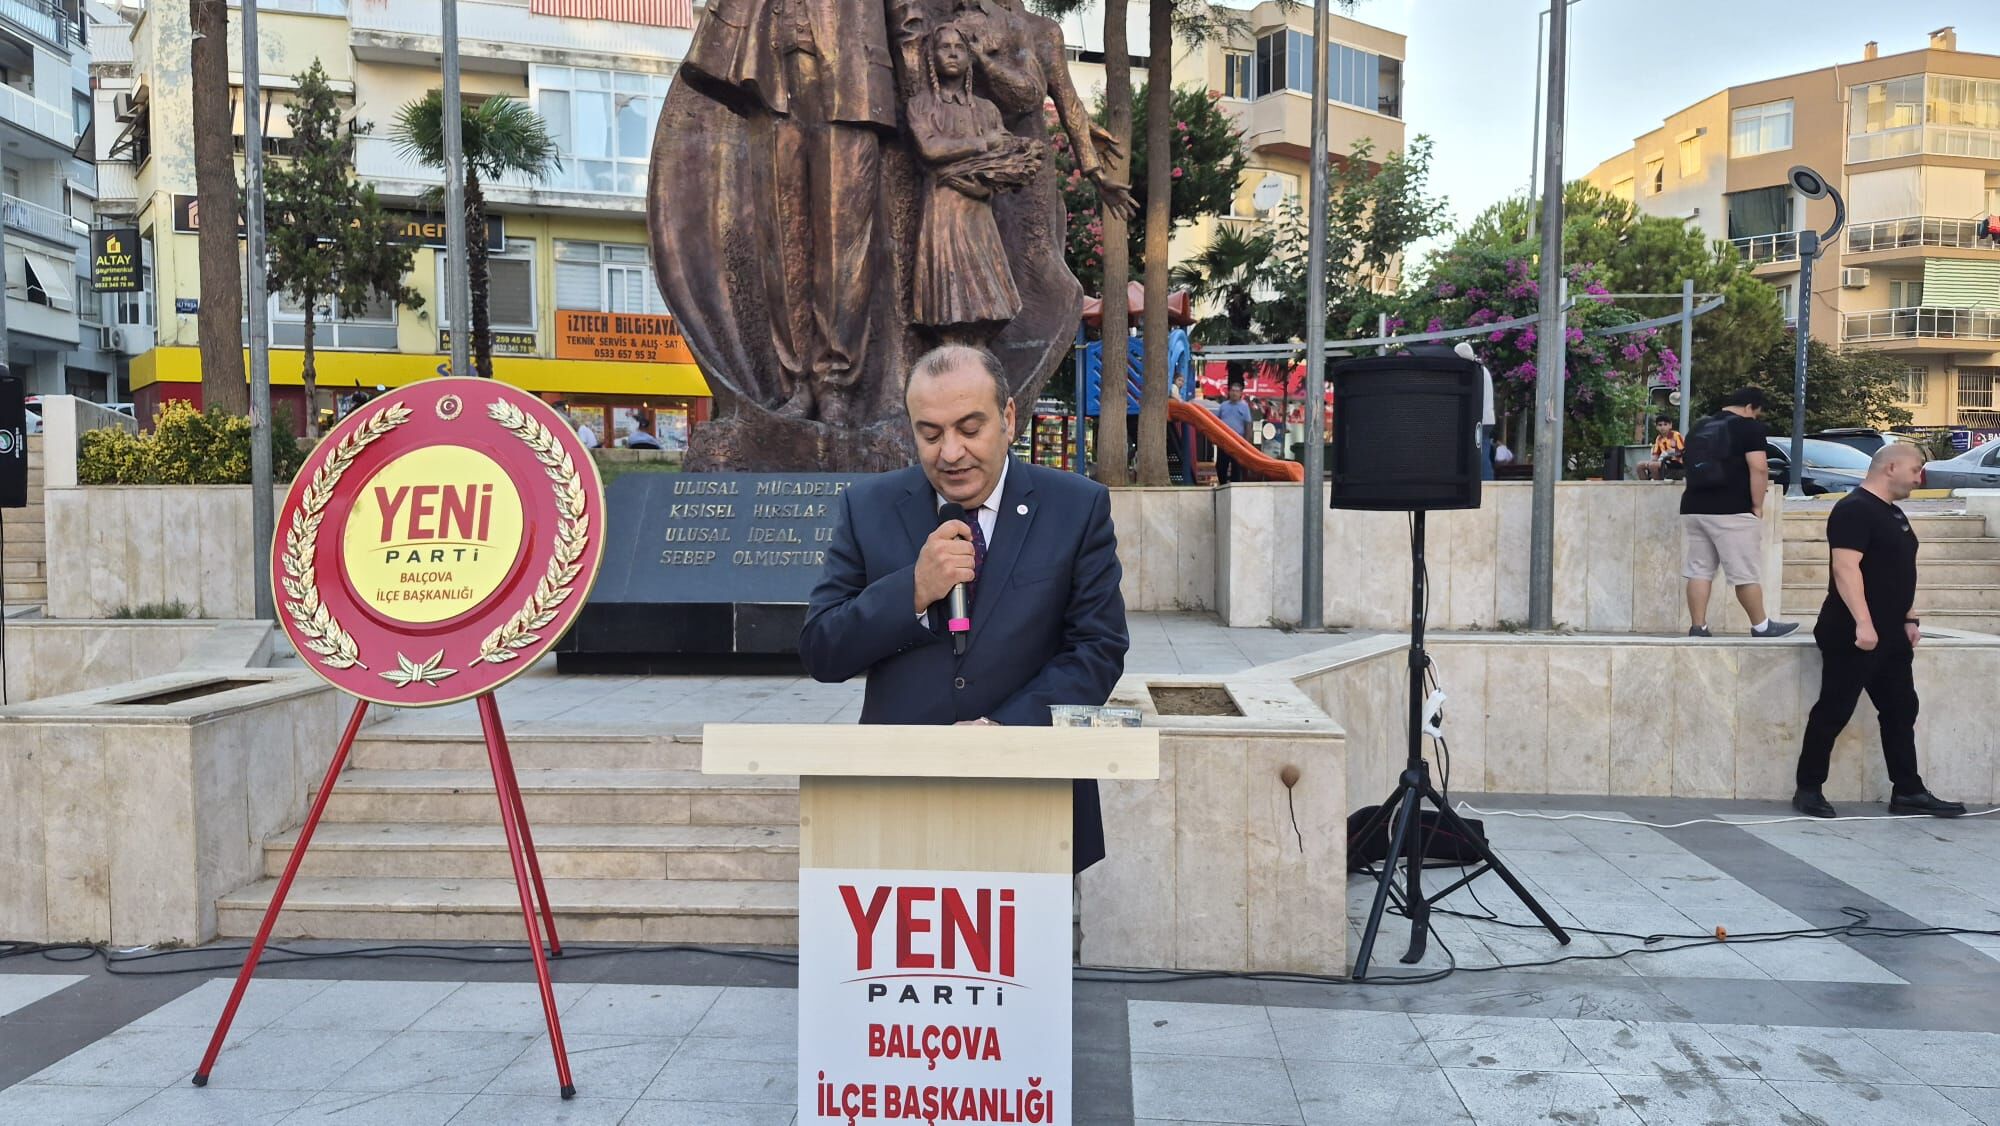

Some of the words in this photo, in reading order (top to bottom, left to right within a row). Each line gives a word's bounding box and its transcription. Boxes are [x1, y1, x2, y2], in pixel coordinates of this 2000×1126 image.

[96, 255, 131, 265] ALTAY
[95, 267, 133, 275] gayrimenkul
[595, 349, 614, 358] 0533
[618, 350, 632, 359] 657
[647, 351, 656, 360] 32
[674, 481, 739, 495] ULUSAL
[665, 527, 731, 541] ULUSAL
[660, 550, 716, 565] SEBEP
[400, 571, 453, 585] BALÇOVA
[376, 588, 400, 604] İLÇE
[403, 586, 473, 603] BAŞKANLIĞI
[868, 1023, 1002, 1070] BALÇOVA
[817, 1070, 877, 1126] İLÇE
[884, 1076, 1054, 1126] BAŞKANLIĞI
